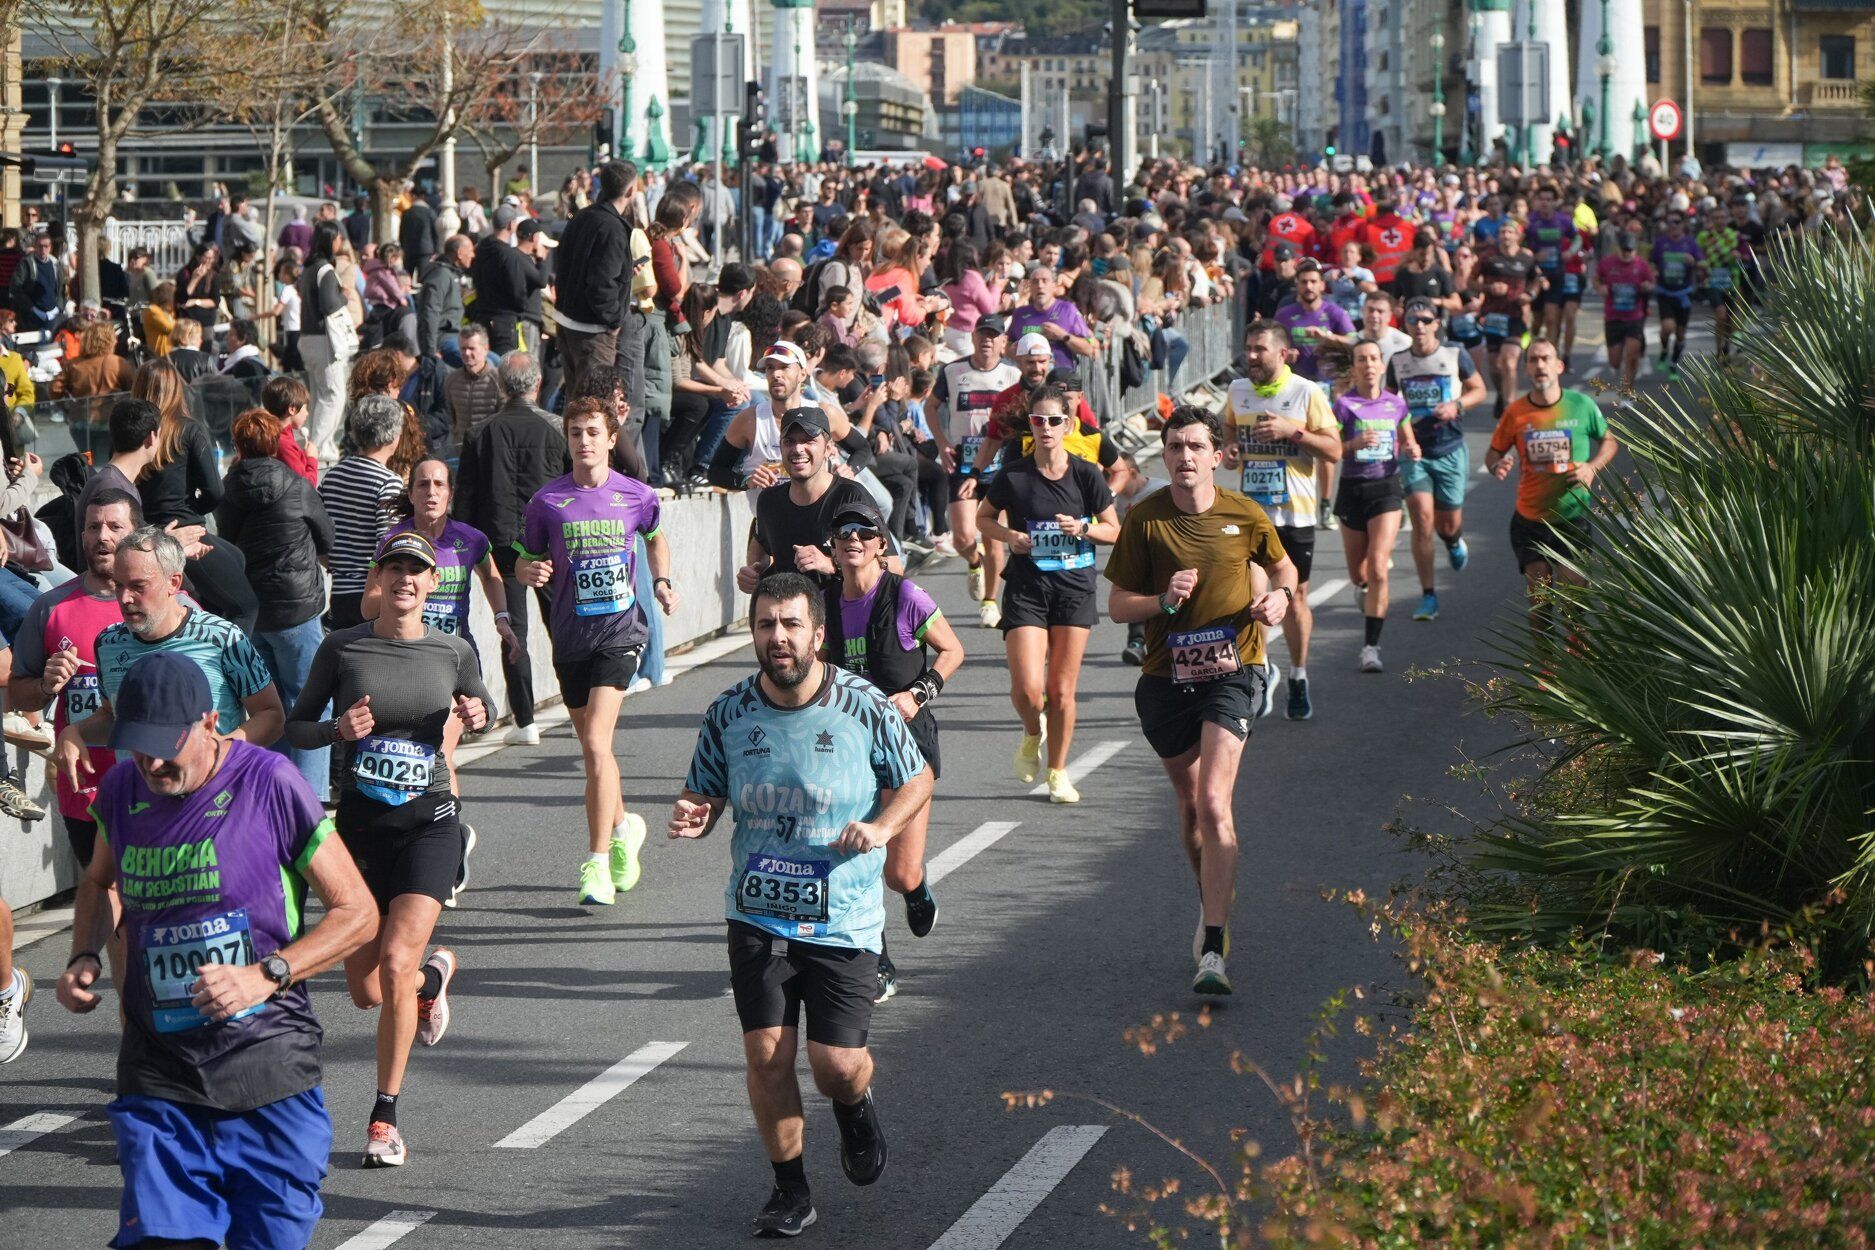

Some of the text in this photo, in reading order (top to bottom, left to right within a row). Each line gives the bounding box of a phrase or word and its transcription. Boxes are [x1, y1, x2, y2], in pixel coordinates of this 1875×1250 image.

[1657, 112, 1675, 126] 40
[1408, 388, 1440, 400] 6059
[1531, 440, 1571, 454] 15794
[1245, 471, 1282, 484] 10271
[562, 519, 626, 539] BEHOBIA
[1033, 533, 1076, 547] 11070
[436, 566, 468, 582] OBIA
[579, 567, 625, 590] 8634
[593, 589, 618, 597] KOLDO
[424, 603, 453, 614] oma
[421, 616, 456, 635] 635
[1176, 642, 1233, 667] 4244
[1190, 666, 1224, 676] GARCIA
[70, 692, 98, 714] 84
[743, 747, 771, 758] FORTUNA
[362, 755, 428, 783] 9029
[740, 782, 833, 816] GOZATU
[776, 815, 797, 844] 57
[121, 837, 218, 876] BEHOBIA
[745, 875, 820, 906] 8353
[153, 940, 241, 981] 10007
